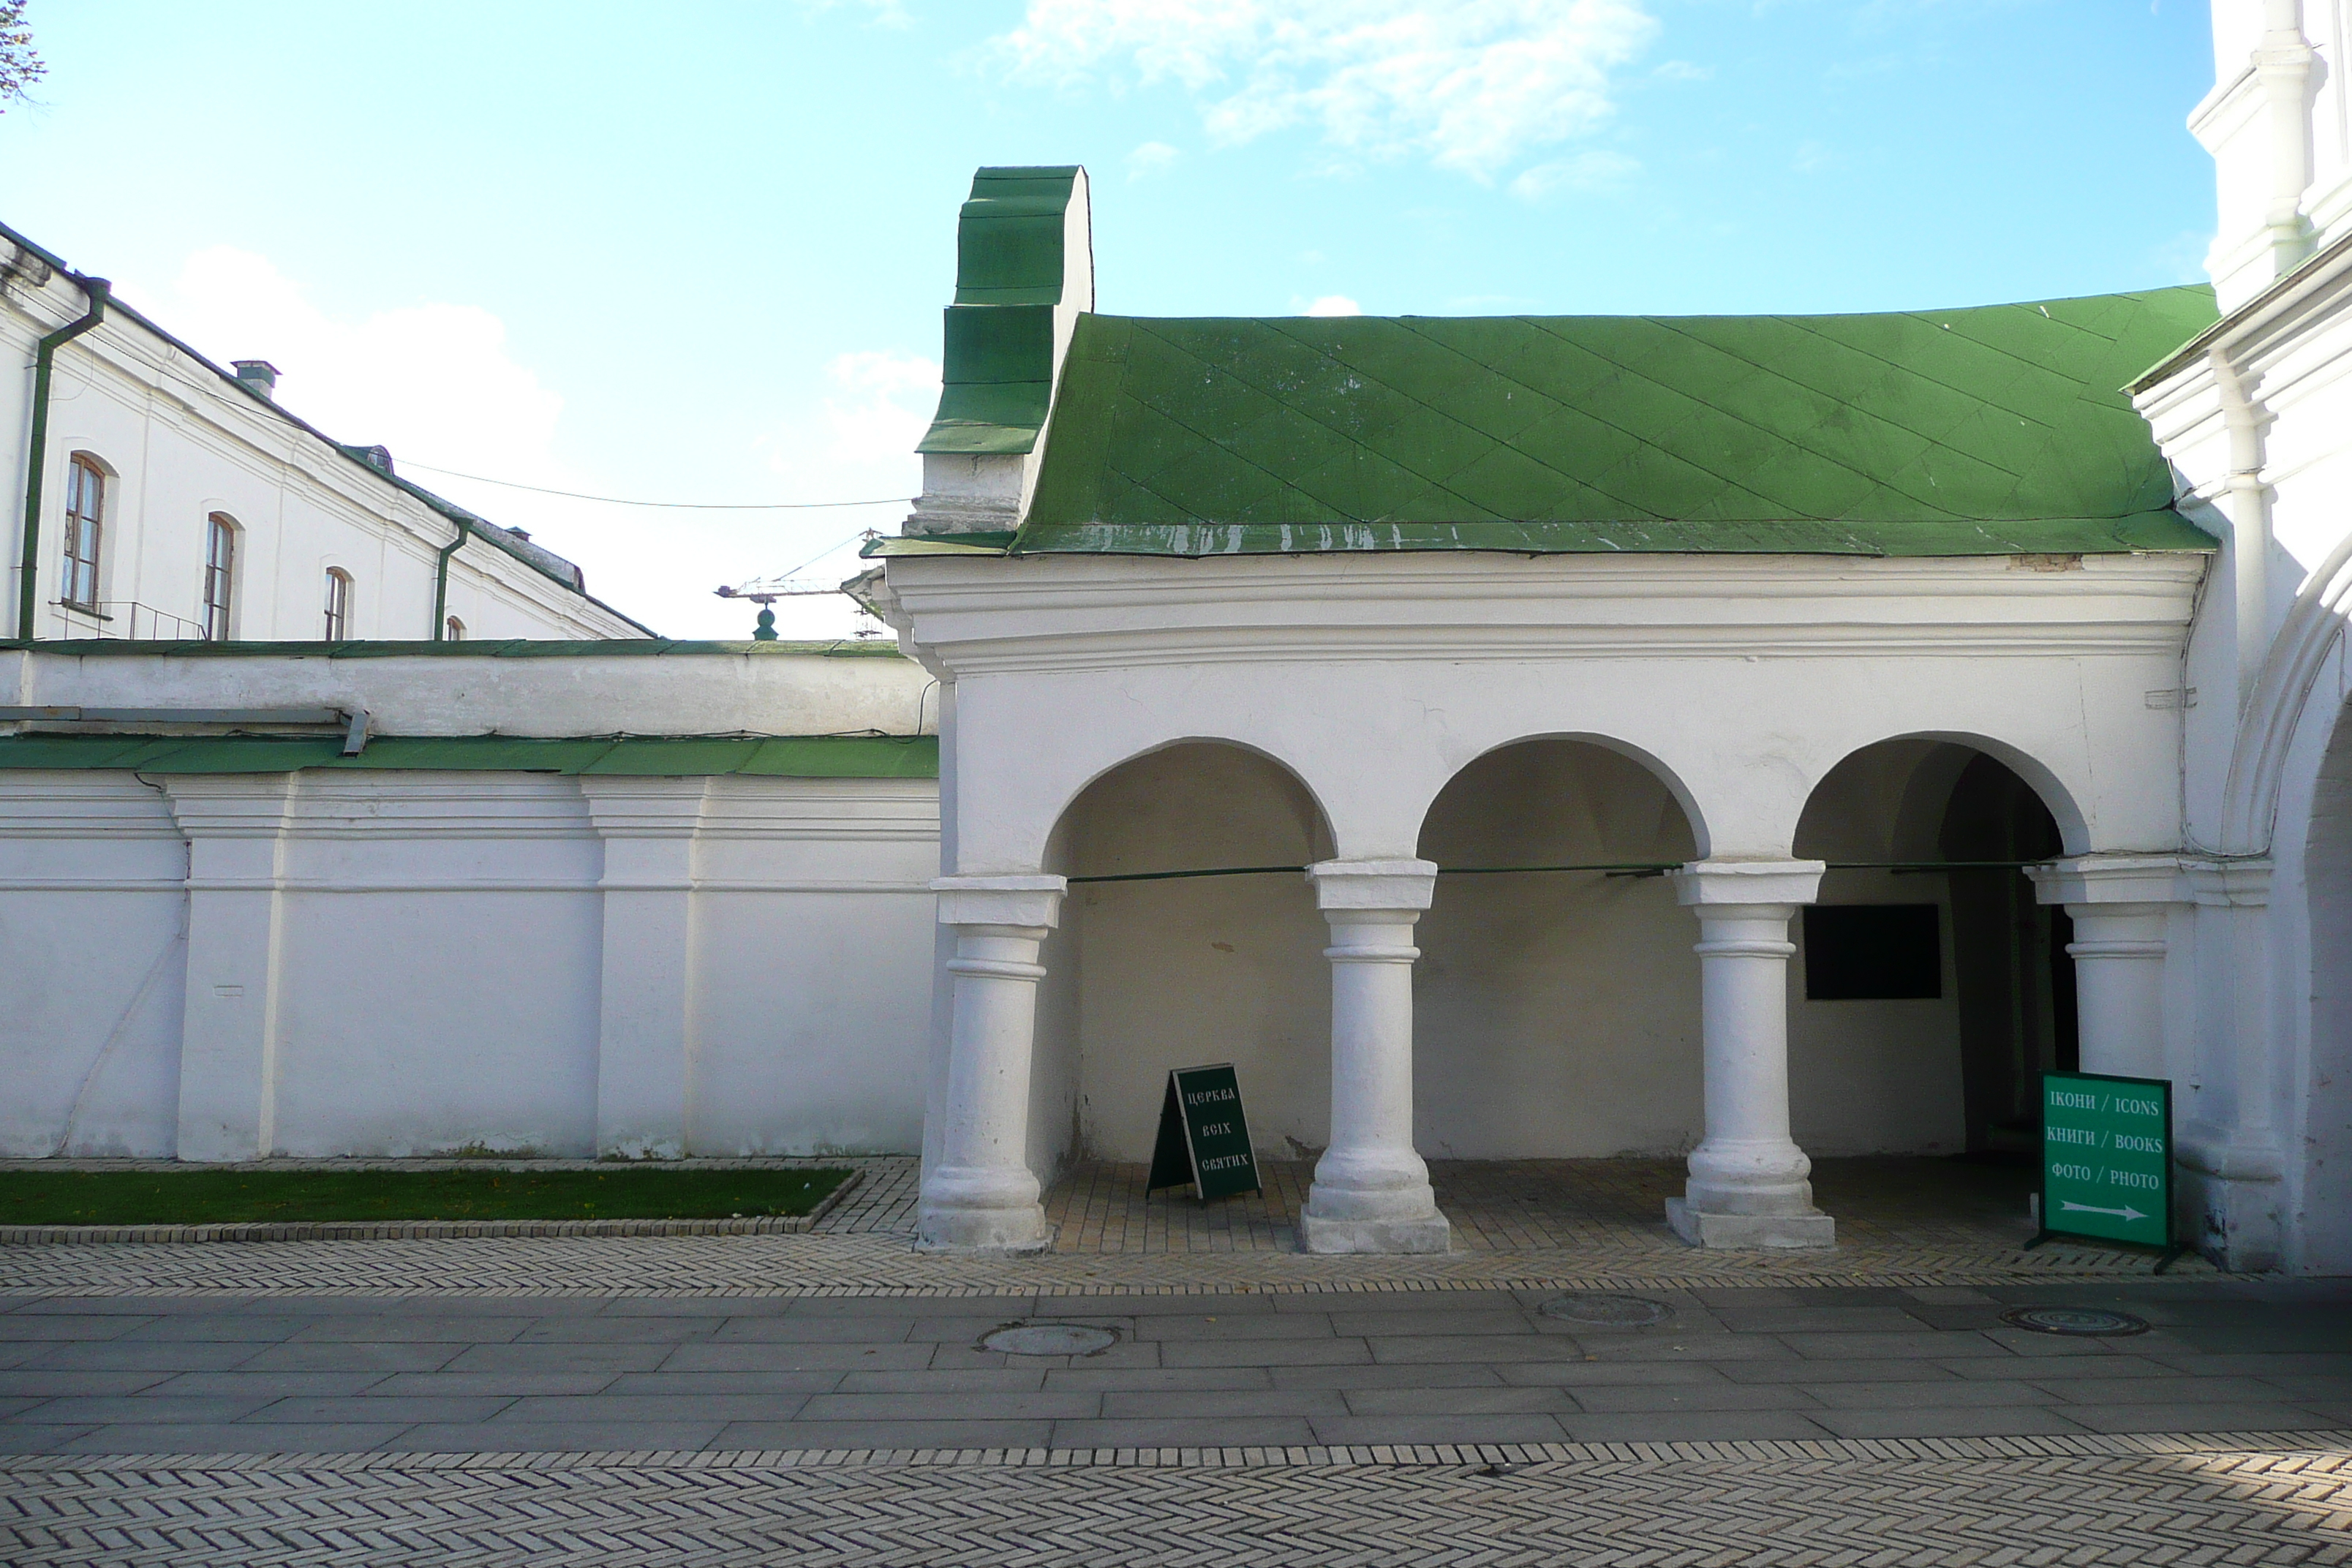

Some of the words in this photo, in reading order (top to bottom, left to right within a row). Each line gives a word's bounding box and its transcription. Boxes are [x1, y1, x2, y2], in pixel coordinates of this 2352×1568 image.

[2050, 1091, 2095, 1109] ІКОНИ
[2115, 1098, 2159, 1116] ICONS
[1202, 1122, 1232, 1137] ВСІХ
[2047, 1126, 2095, 1145] КНИГИ
[2115, 1135, 2163, 1153] BOOKS
[1202, 1153, 1248, 1172] СВЯТИХ
[2051, 1163, 2091, 1180] ФОТО
[2110, 1170, 2159, 1190] PHOTO
